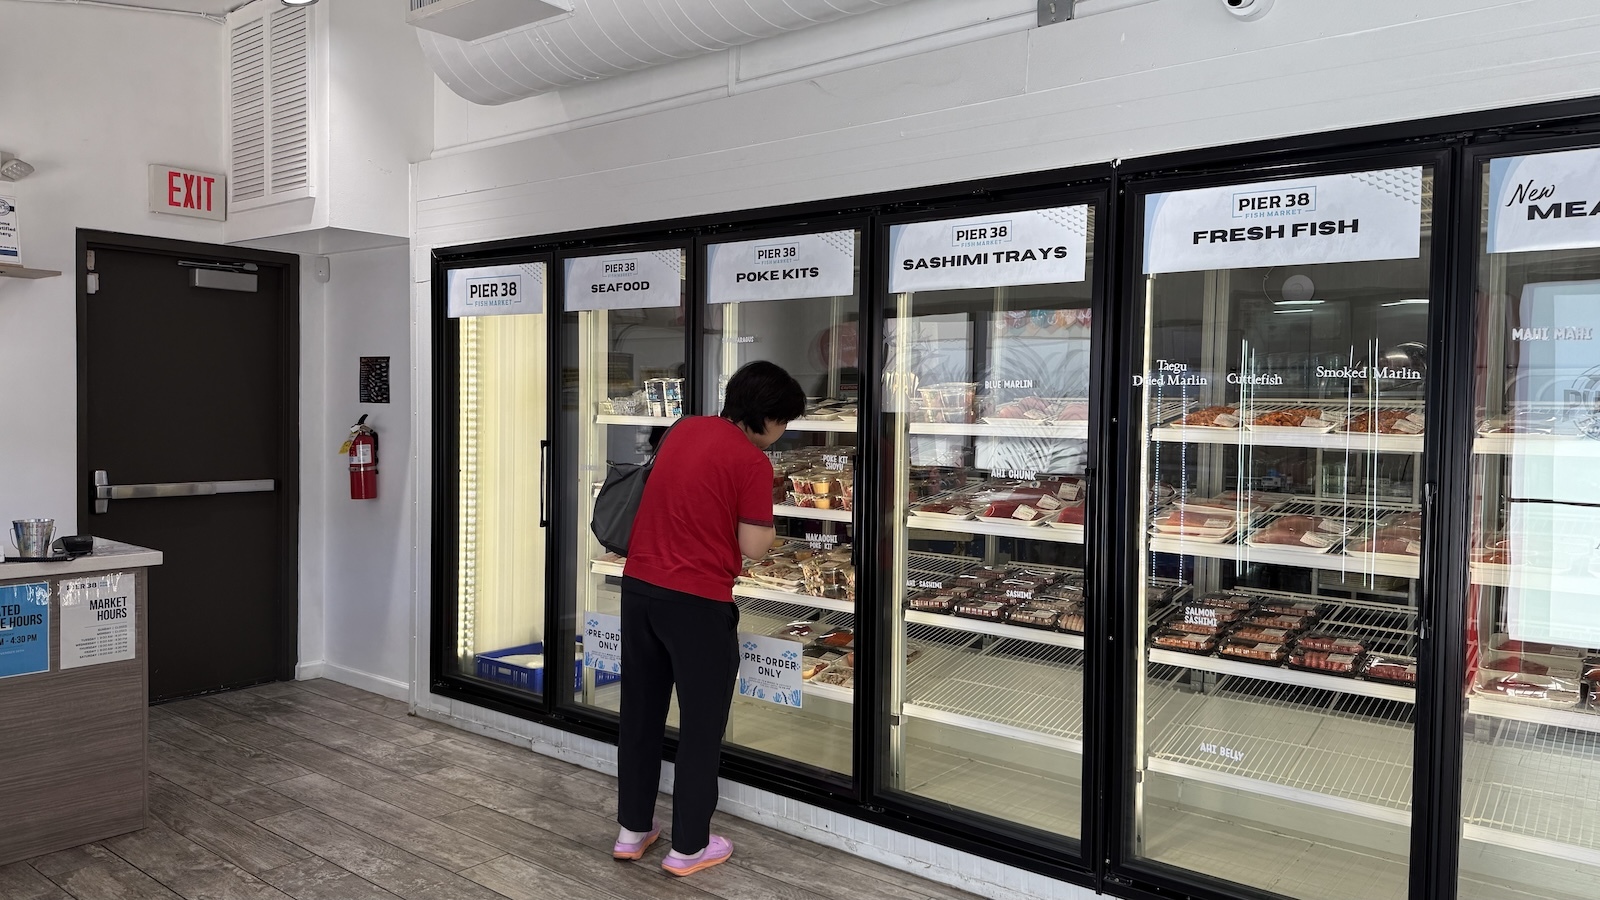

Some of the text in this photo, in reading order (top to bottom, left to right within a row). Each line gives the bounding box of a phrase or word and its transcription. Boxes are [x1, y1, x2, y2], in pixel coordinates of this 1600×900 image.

[168, 171, 215, 211] EXIT
[1505, 179, 1556, 207] New
[1238, 192, 1310, 212] PIER 38
[1245, 208, 1302, 219] FISH MARKET
[956, 226, 1008, 241] PIER 38
[1193, 218, 1359, 245] FRESH FISH
[758, 246, 796, 260] PIER 38
[903, 246, 1068, 271] SASHIMI TRAYS
[605, 262, 635, 273] PIER 38
[736, 267, 819, 283] POKE KITS
[470, 281, 517, 298] PIER 38
[591, 281, 650, 293] SEAFOOD
[489, 299, 512, 307] MARKET
[1512, 327, 1593, 341] MAHI MAHI
[1157, 359, 1188, 373] Taegu
[1315, 365, 1421, 380] Smoked Marlin
[984, 379, 1033, 389] BLUE MARLIN
[1132, 374, 1208, 386] Died Marlin
[1226, 372, 1283, 385] Cuttlefish
[823, 454, 848, 464] POKE KIT
[825, 462, 844, 470] SHOYU
[990, 468, 1037, 480] AHI CHUNK
[805, 533, 838, 544] NAKAOCHI
[809, 541, 822, 549] POKE
[919, 580, 943, 589] SASHIMI
[1005, 589, 1033, 600] SASHIMI
[89, 596, 128, 610] MARKET
[0, 604, 21, 616] TED
[97, 607, 128, 621] HOURS
[1184, 606, 1216, 617] SALMON
[9, 613, 43, 628] HOURS
[1184, 615, 1218, 627] SASHIMI
[11, 635, 26, 644] 4:30
[27, 634, 38, 642] PM
[598, 640, 618, 651] ONLY
[744, 652, 797, 671] PRE-ORDER
[758, 666, 781, 679] ONLY
[1200, 742, 1245, 761] AHI BELLY
